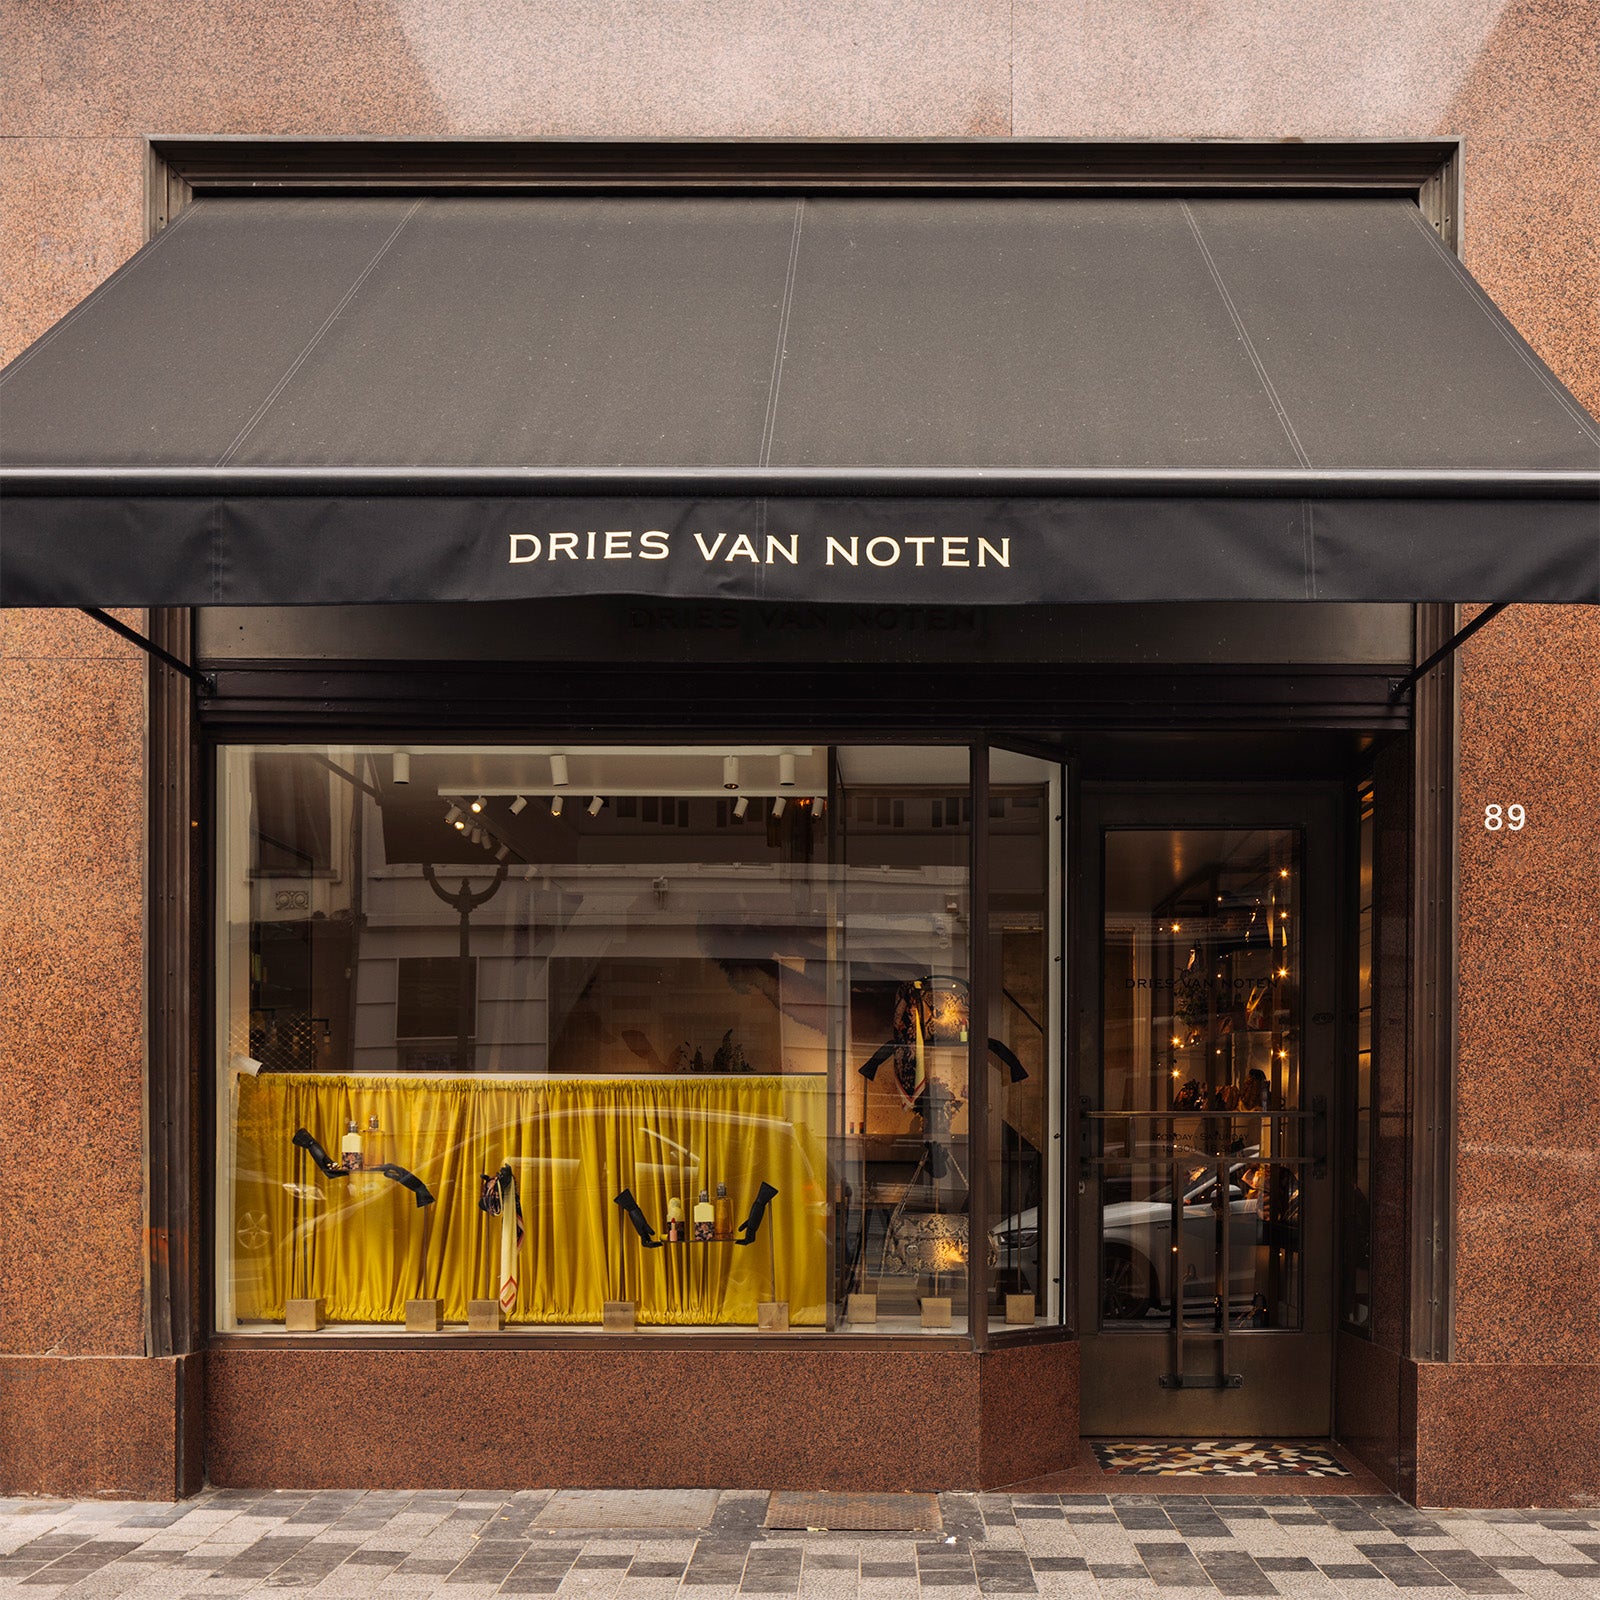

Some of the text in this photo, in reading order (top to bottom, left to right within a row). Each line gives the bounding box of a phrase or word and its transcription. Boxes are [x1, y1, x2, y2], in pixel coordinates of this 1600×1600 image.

[508, 530, 1011, 567] DRIES VAN NOTEN
[630, 608, 976, 631] DRIES VAN NOTEN
[1484, 804, 1526, 831] 89
[1125, 977, 1278, 989] DRIES VAN NOTEN
